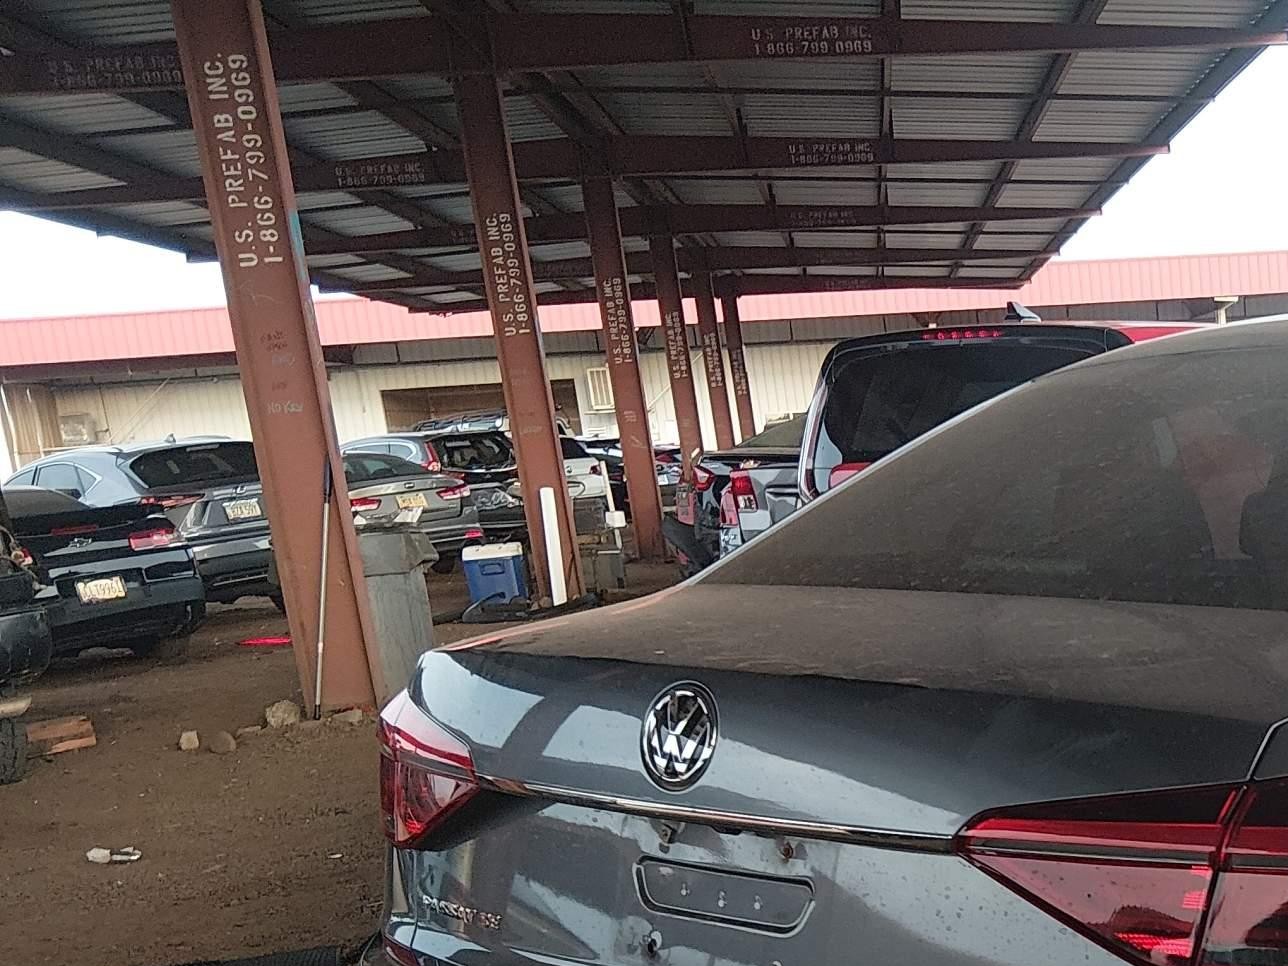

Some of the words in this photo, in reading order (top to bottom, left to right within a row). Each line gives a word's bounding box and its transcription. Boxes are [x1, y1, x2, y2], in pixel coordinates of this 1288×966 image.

[785, 26, 839, 39] PREFAB
[204, 53, 229, 100] INC.
[213, 113, 249, 208] PREFAB
[228, 54, 283, 263] 1-866-799-0969
[234, 222, 258, 267] U.S.
[486, 213, 500, 240] INC.
[490, 247, 511, 302] PREFAB
[499, 213, 530, 334] 1-866-799-0969
[503, 309, 517, 336] U.S.
[606, 301, 620, 340] PREFAB
